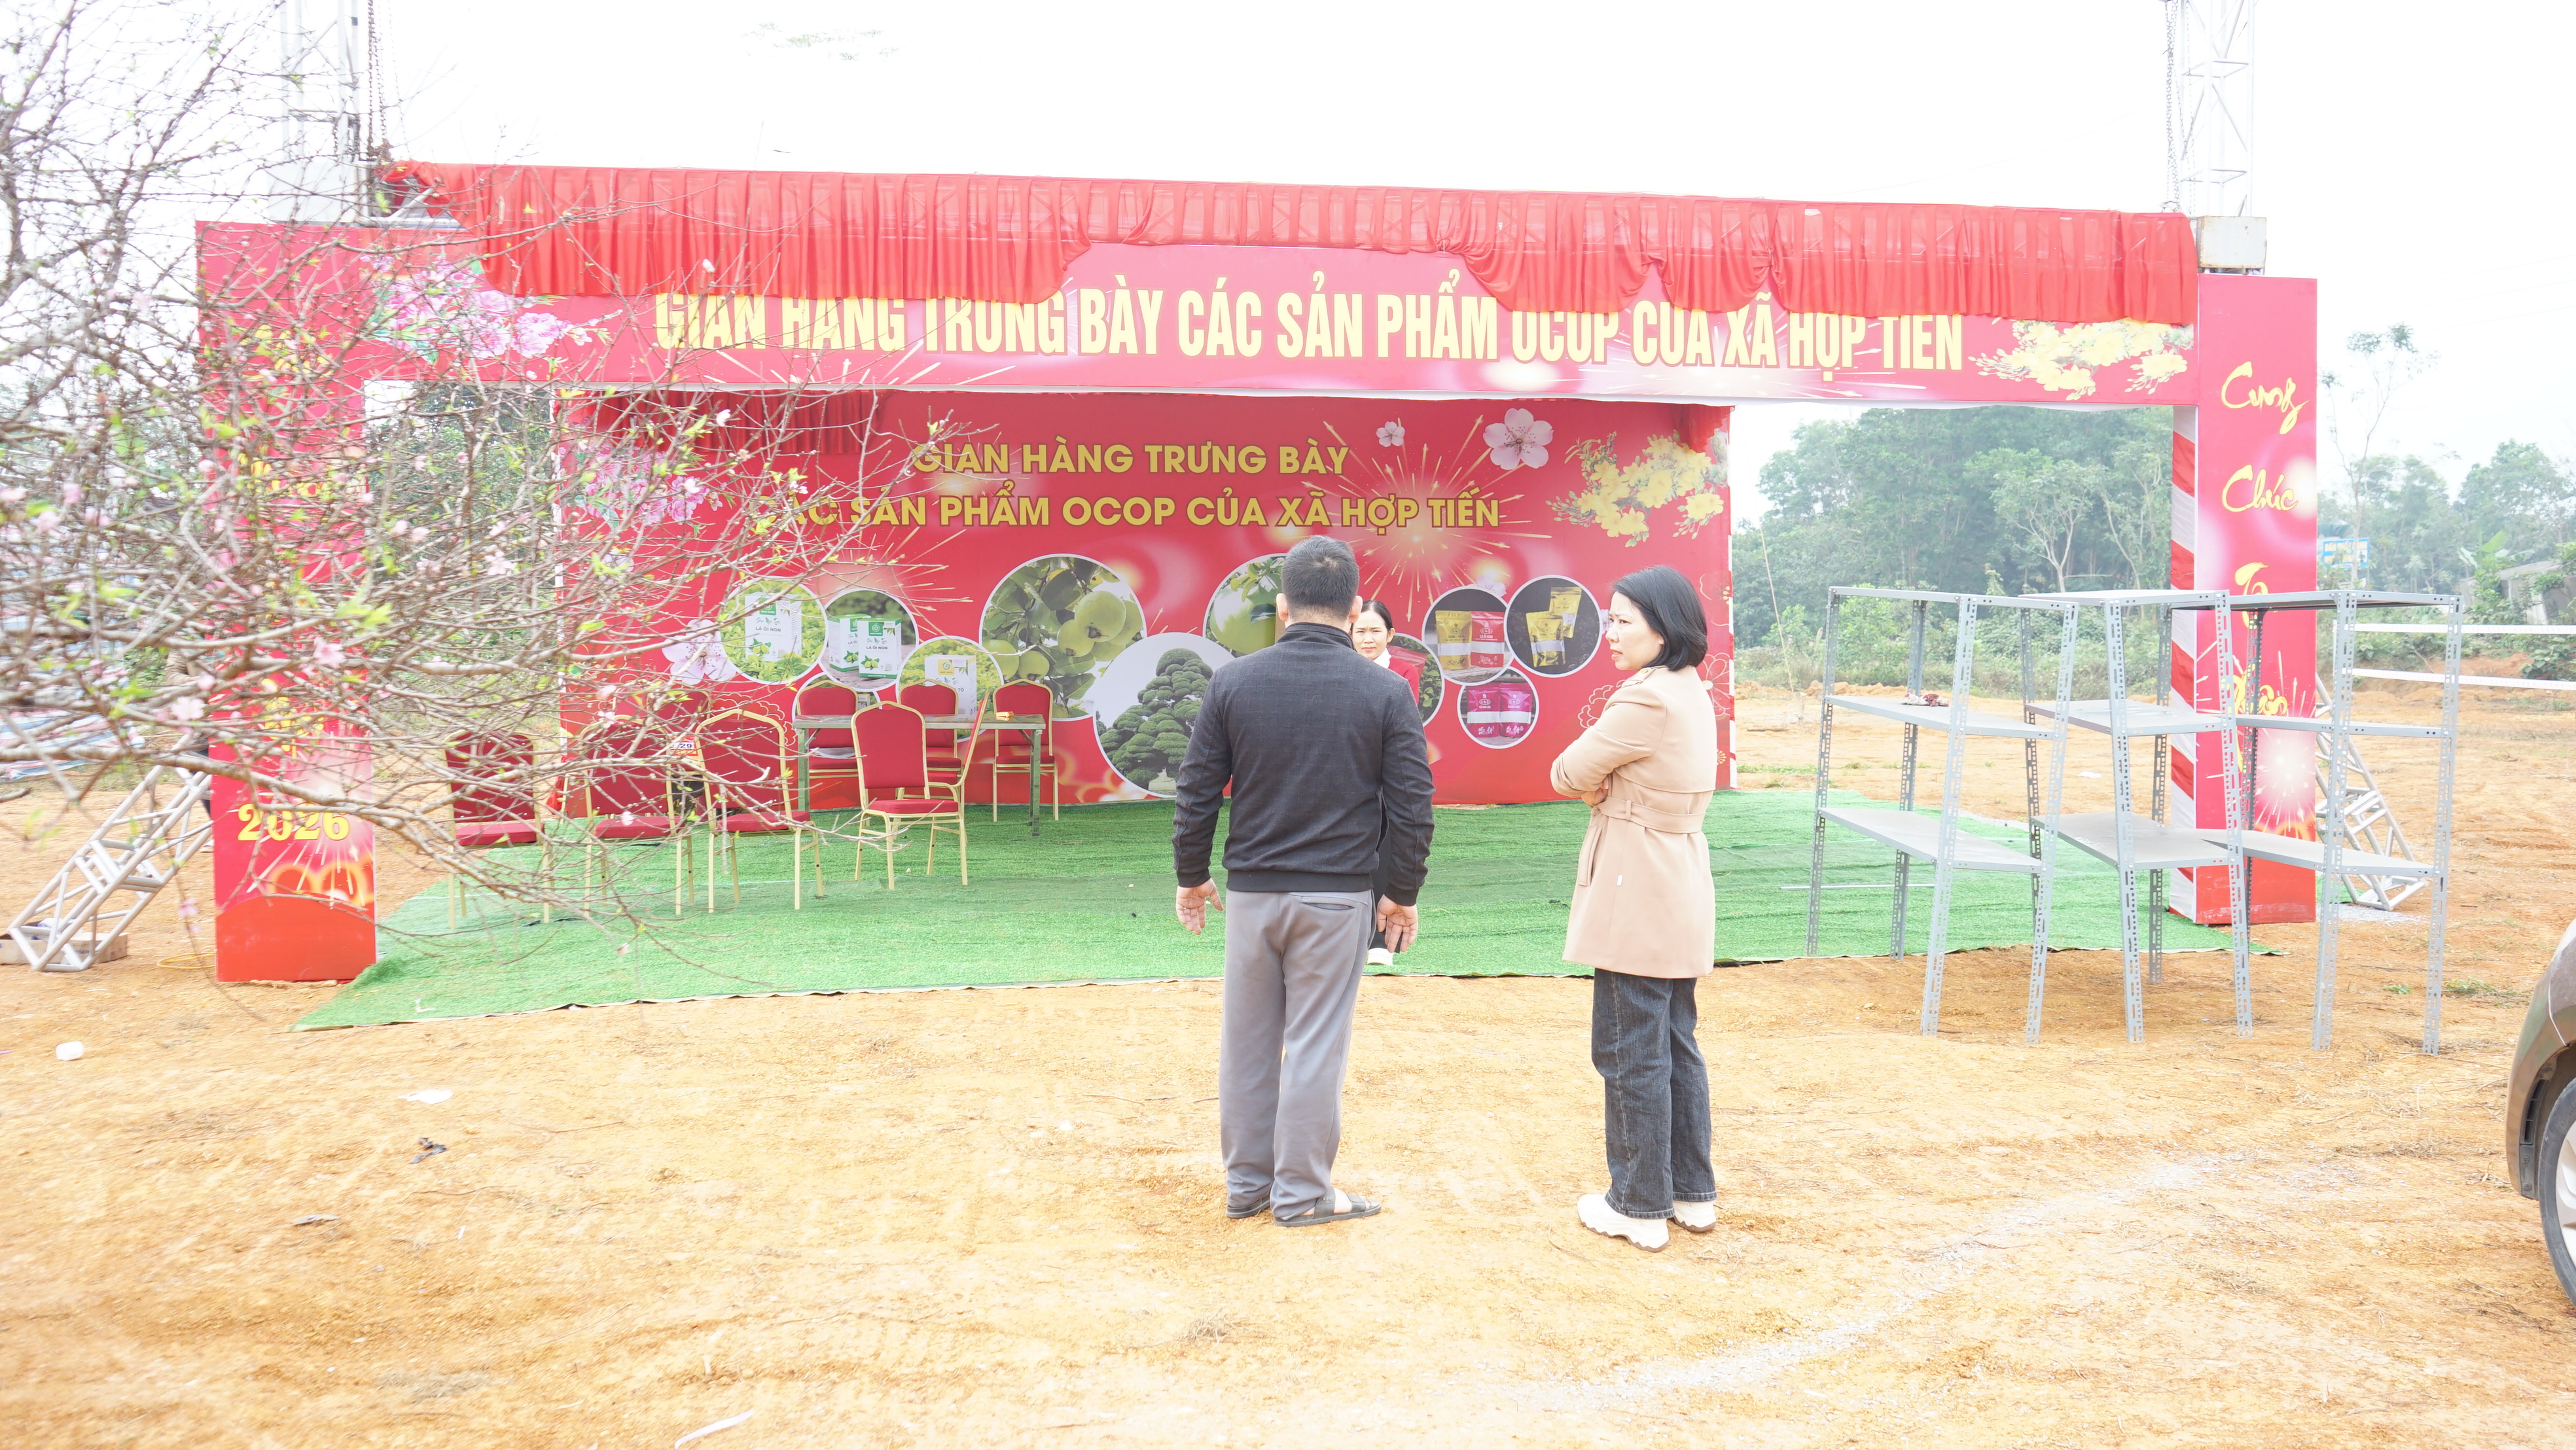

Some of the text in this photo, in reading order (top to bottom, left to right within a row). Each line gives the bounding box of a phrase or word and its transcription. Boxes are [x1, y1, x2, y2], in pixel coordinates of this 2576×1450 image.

[655, 292, 766, 349] GIAN
[1079, 274, 1164, 355] BÀY
[1177, 277, 1262, 357] CÁC
[1276, 270, 1363, 359] SẢN
[1377, 268, 1498, 360] PHẨM
[1512, 309, 1619, 362] OCOP
[1724, 291, 1778, 366] XÃ
[2221, 361, 2309, 434] Cung
[913, 435, 1350, 475] GIAN HÀNG TRƯNG BÀY
[850, 486, 927, 526] SẢN
[939, 480, 1049, 527] PHẨM
[1062, 496, 1175, 527] OCOP
[1186, 487, 1268, 527] CỦA
[1278, 489, 1332, 527] XÃ
[1342, 493, 1419, 535] HỢP
[1427, 487, 1499, 527] TIẾN
[2222, 465, 2299, 512] Chúc
[238, 803, 351, 841] 2026
